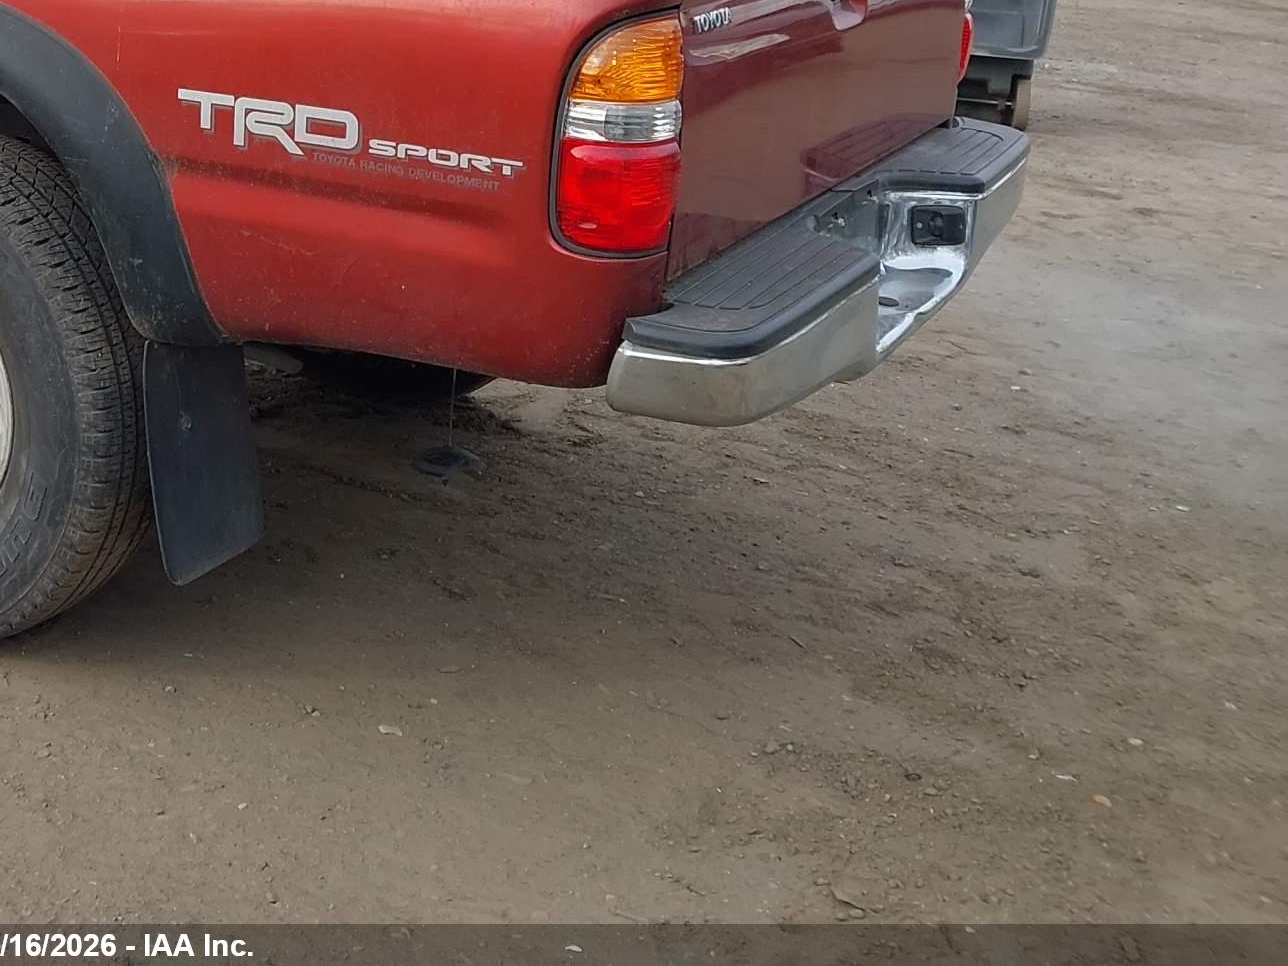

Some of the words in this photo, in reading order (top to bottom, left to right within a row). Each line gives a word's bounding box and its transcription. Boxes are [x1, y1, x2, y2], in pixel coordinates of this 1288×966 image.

[693, 7, 734, 33] TOYOTA
[177, 87, 361, 156] TRD
[368, 138, 526, 177] SPORT
[312, 152, 357, 169] TOYOTA
[359, 159, 405, 176] RACING
[408, 167, 501, 191] DEVELOPMENT
